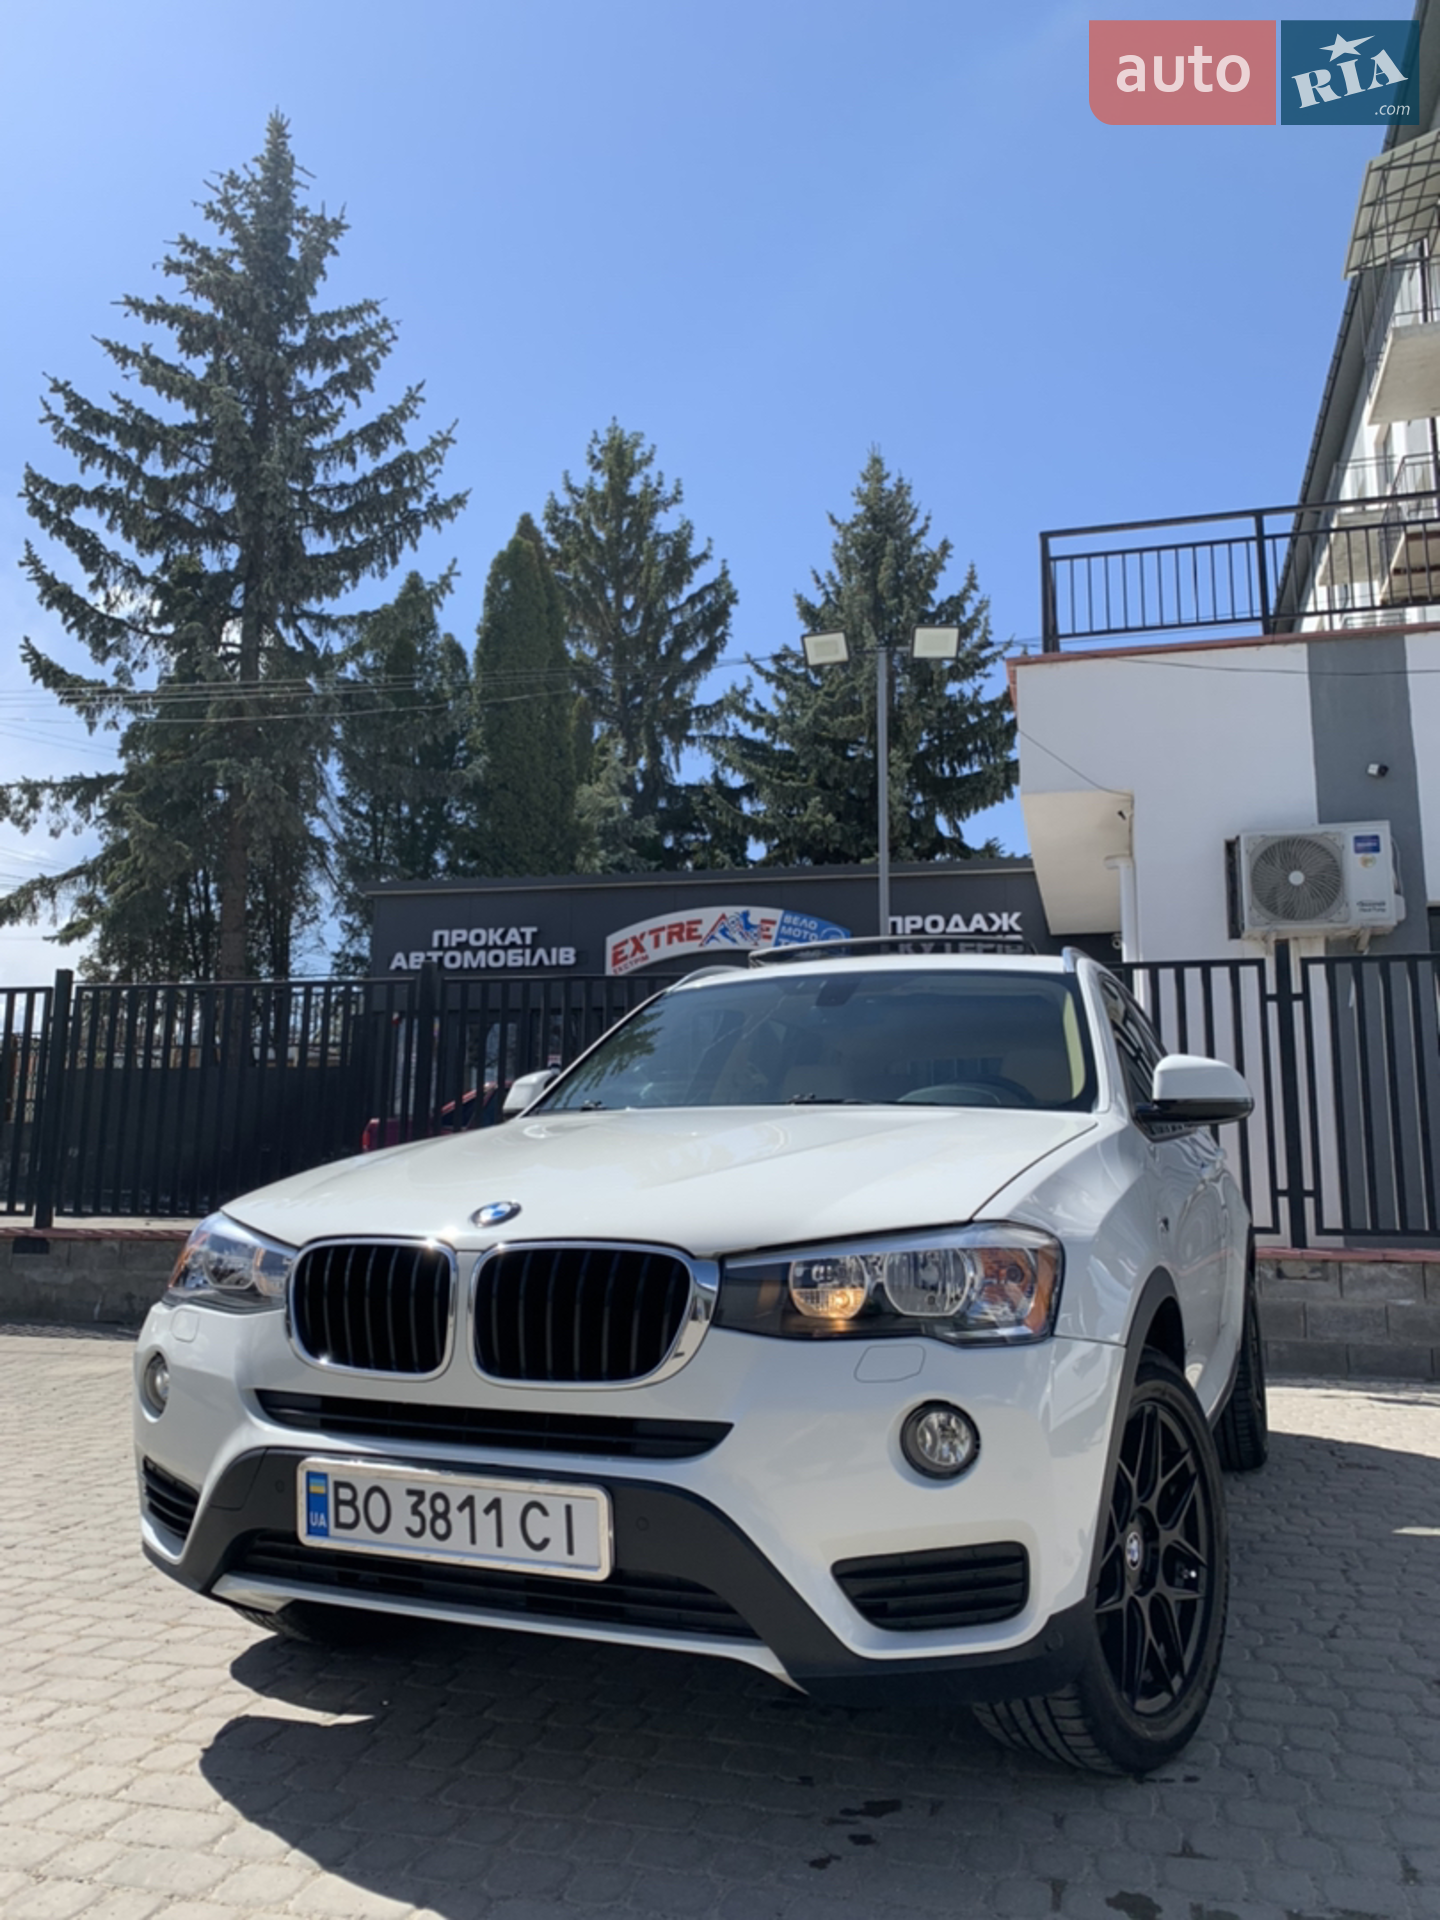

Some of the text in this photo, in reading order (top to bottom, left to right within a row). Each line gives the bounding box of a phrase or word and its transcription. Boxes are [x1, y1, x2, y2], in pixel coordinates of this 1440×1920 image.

[780, 926, 819, 942] МОТО
[888, 912, 1023, 934] ПРОДАЖ
[432, 926, 538, 948] ПРОКАТ
[389, 947, 576, 970] АВТОМОБІЛІВ
[309, 1512, 327, 1528] UA
[333, 1480, 392, 1535] BO
[405, 1488, 503, 1549] 3811
